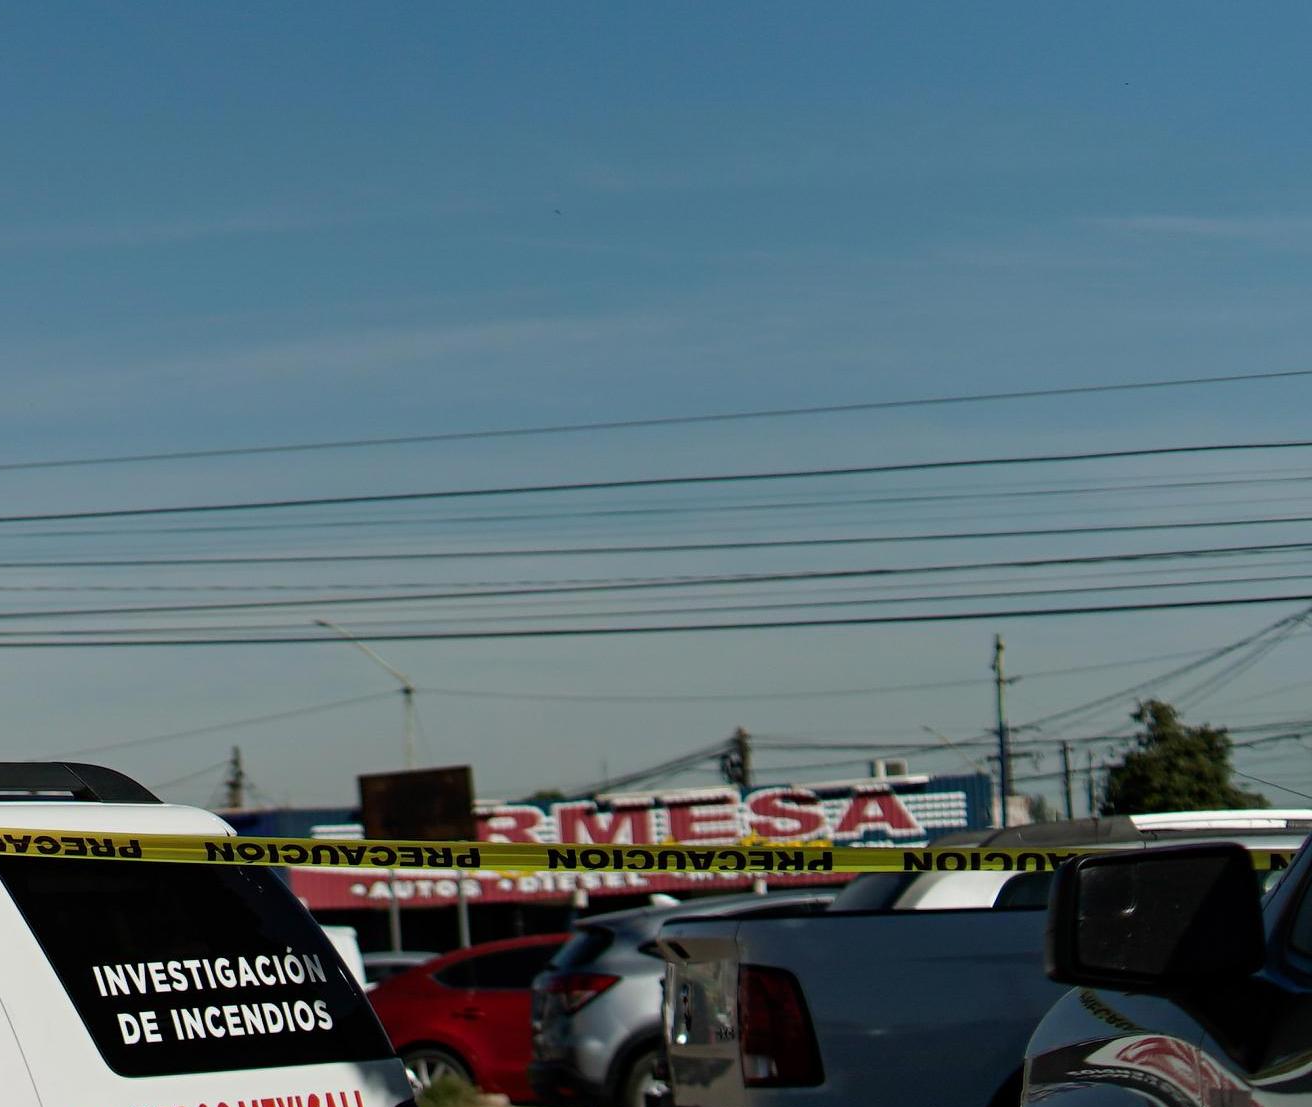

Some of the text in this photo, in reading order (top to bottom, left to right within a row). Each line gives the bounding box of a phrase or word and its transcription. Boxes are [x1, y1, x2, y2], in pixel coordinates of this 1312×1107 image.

[473, 784, 926, 845] RMESA
[369, 879, 482, 899] AUTOS
[517, 871, 649, 894] DIESEL
[92, 946, 327, 997] INVESTIGACIÓN
[117, 1000, 334, 1045] DE INCENDIOS
